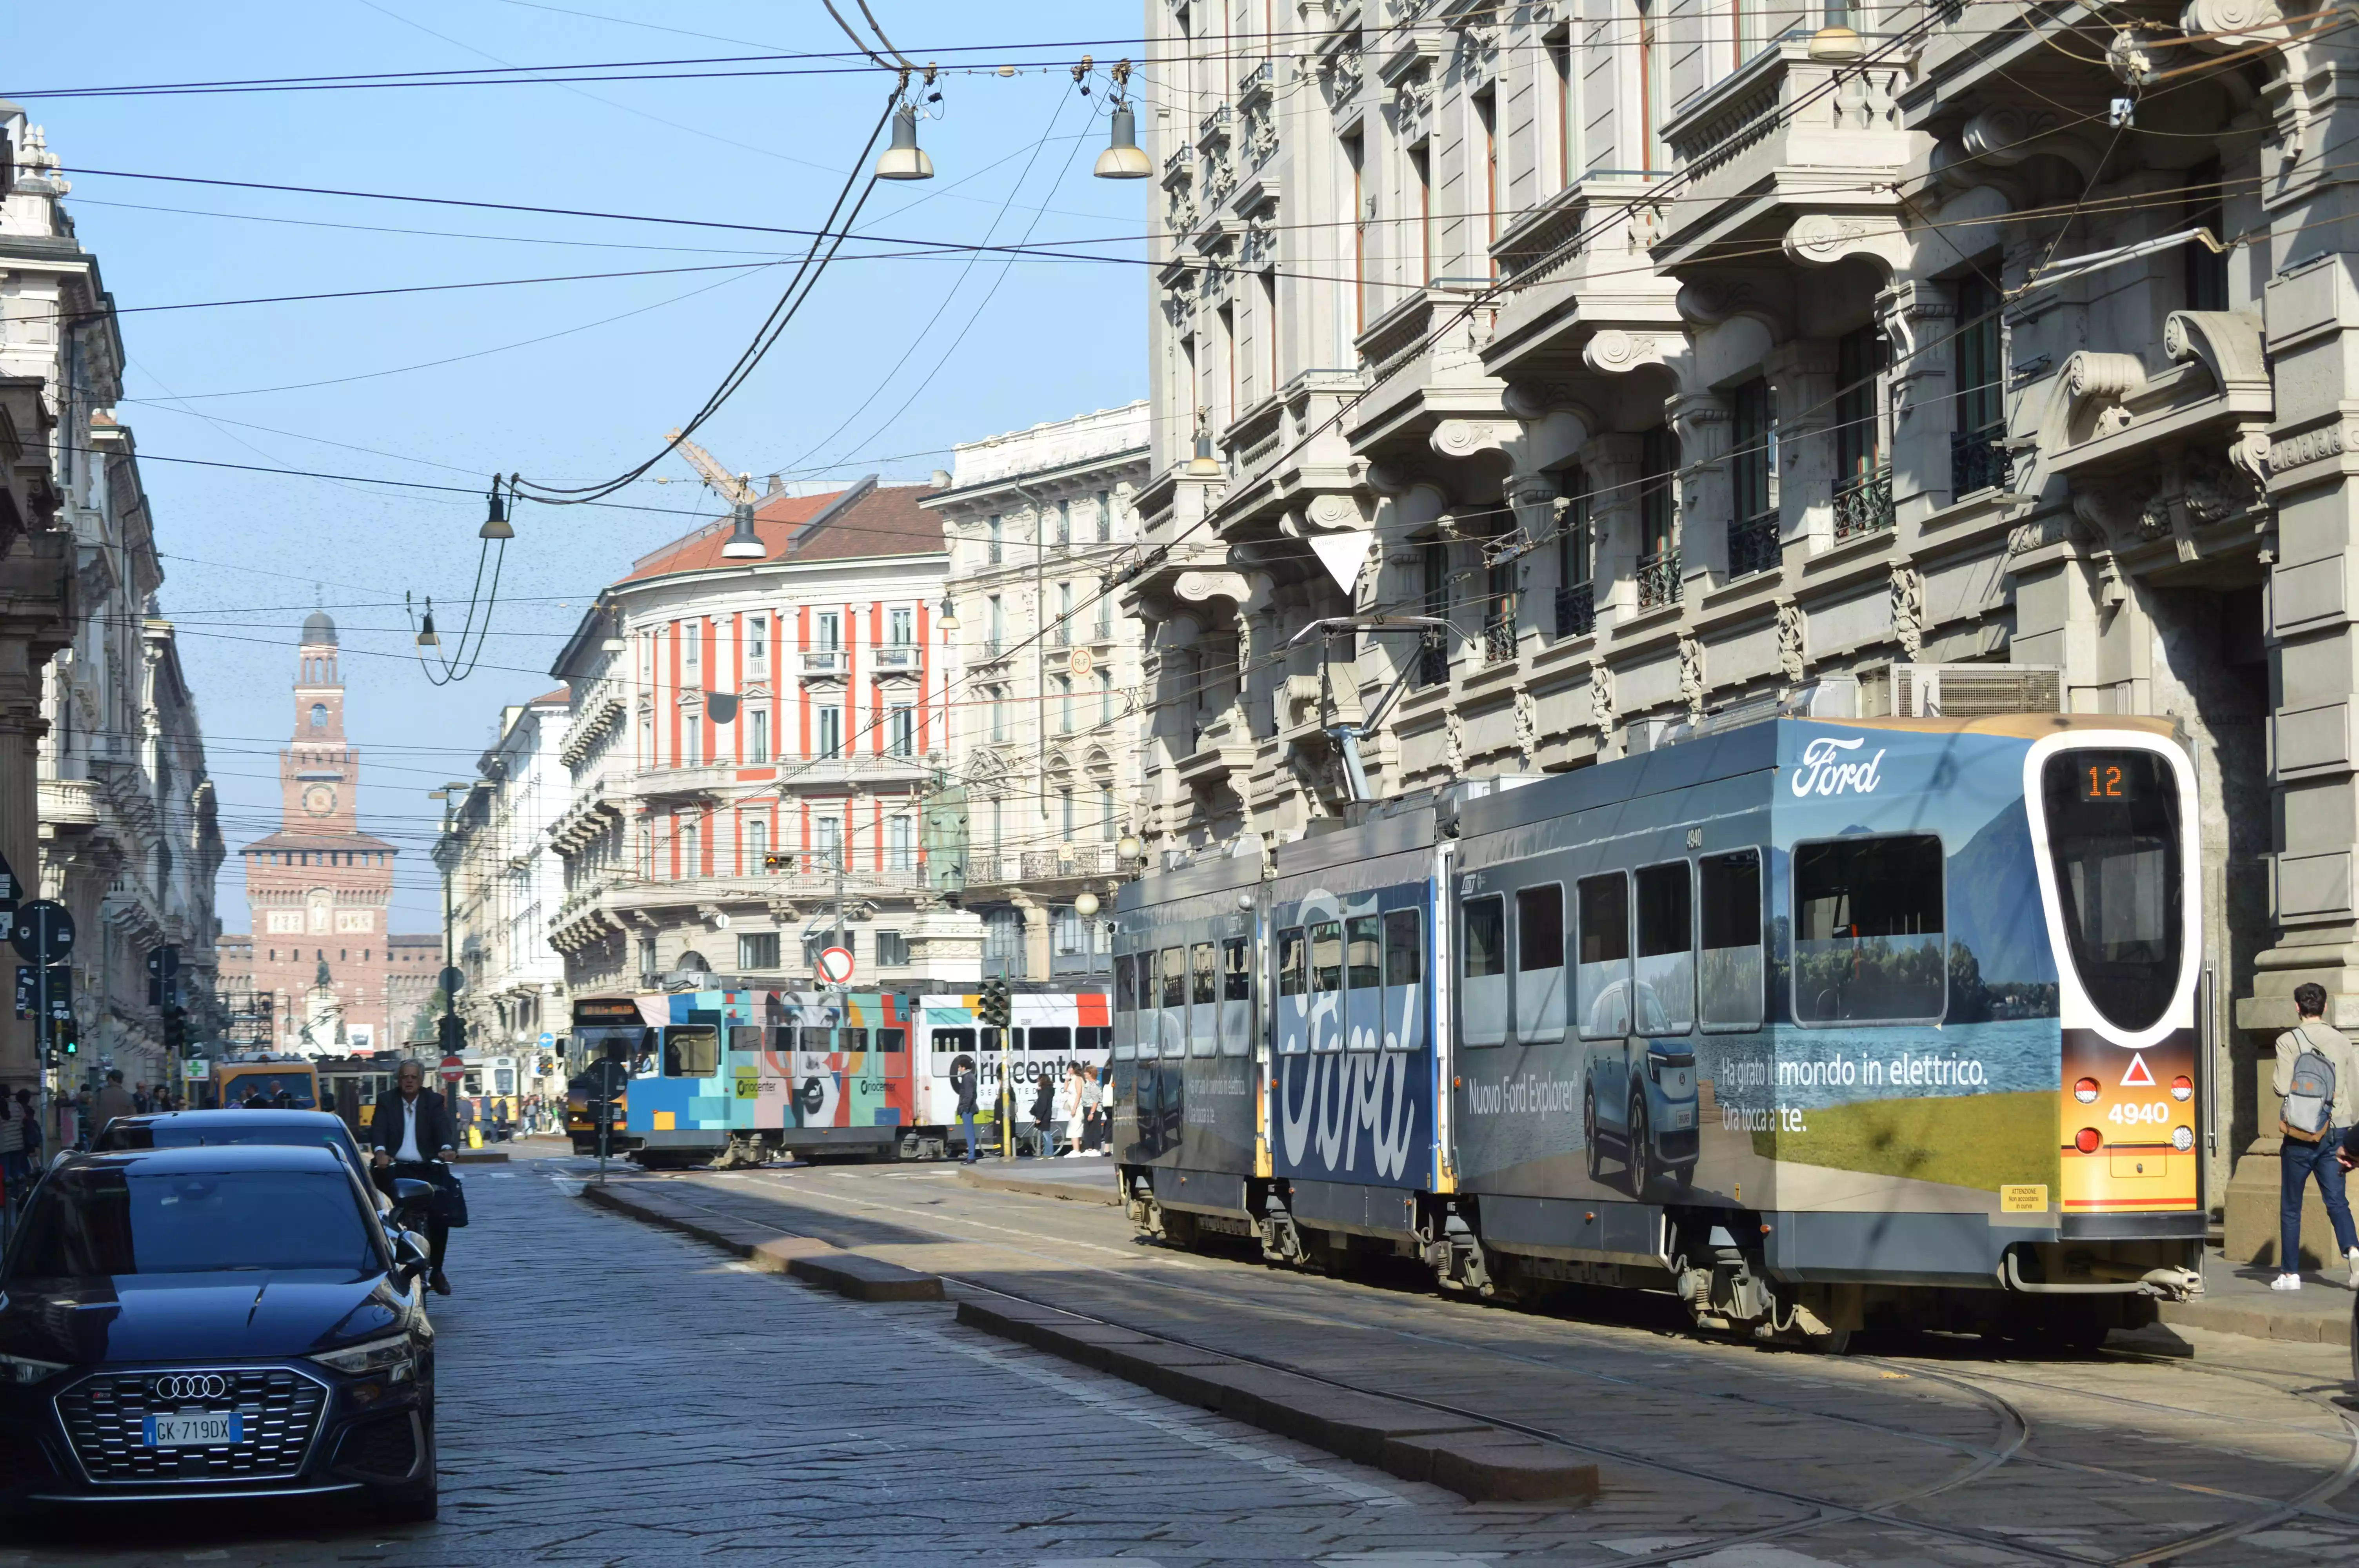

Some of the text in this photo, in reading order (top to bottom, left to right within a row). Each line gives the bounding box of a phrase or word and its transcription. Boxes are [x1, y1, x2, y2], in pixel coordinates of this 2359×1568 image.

[1792, 737, 1886, 797] Ford
[2089, 766, 2122, 797] 12
[1687, 828, 1701, 848] 4940
[1282, 888, 1414, 1181] Ford
[1723, 1052, 1988, 1092] Ha girato il mondo in elettrico.
[1469, 1078, 1501, 1114] Nuovo
[1503, 1073, 1526, 1113] Ford
[1723, 1102, 1807, 1132] Ora tocca a te.
[2108, 1102, 2168, 1125] 4940
